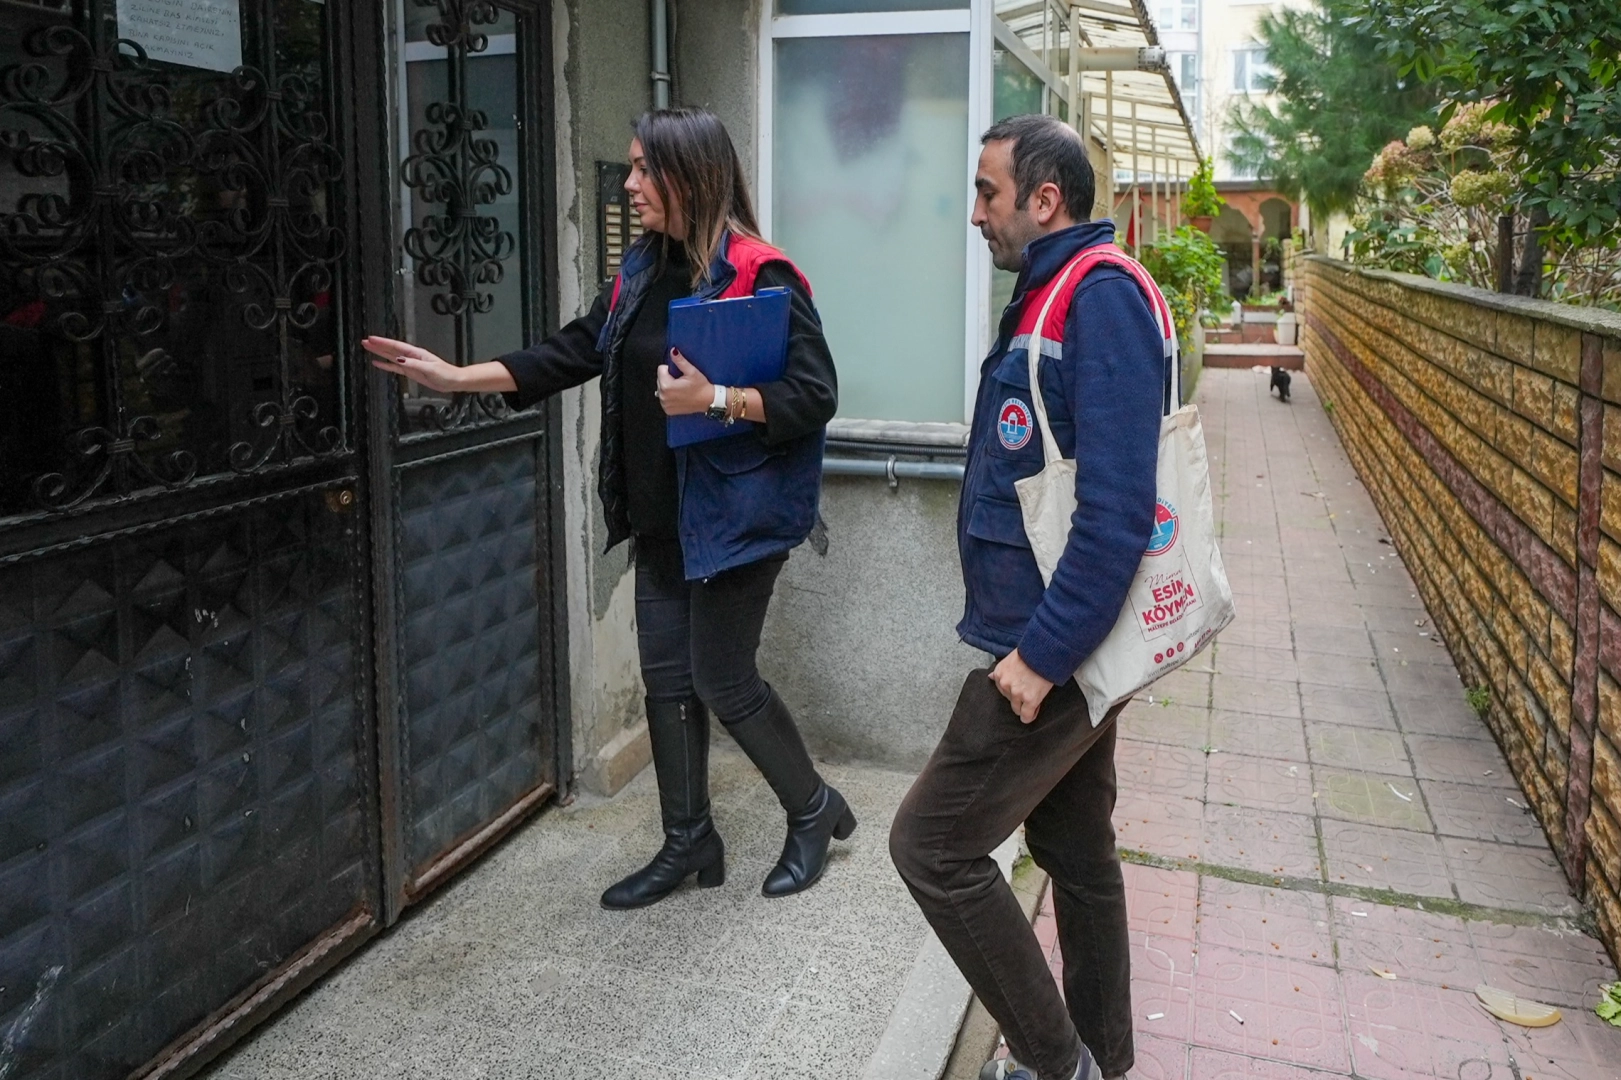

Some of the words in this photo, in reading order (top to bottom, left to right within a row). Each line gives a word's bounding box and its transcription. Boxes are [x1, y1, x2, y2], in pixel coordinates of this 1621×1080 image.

[163, 10, 181, 19] BAS
[1157, 497, 1177, 516] DİYESİ
[1152, 577, 1184, 603] ESİN
[1142, 583, 1195, 626] KÖYMN
